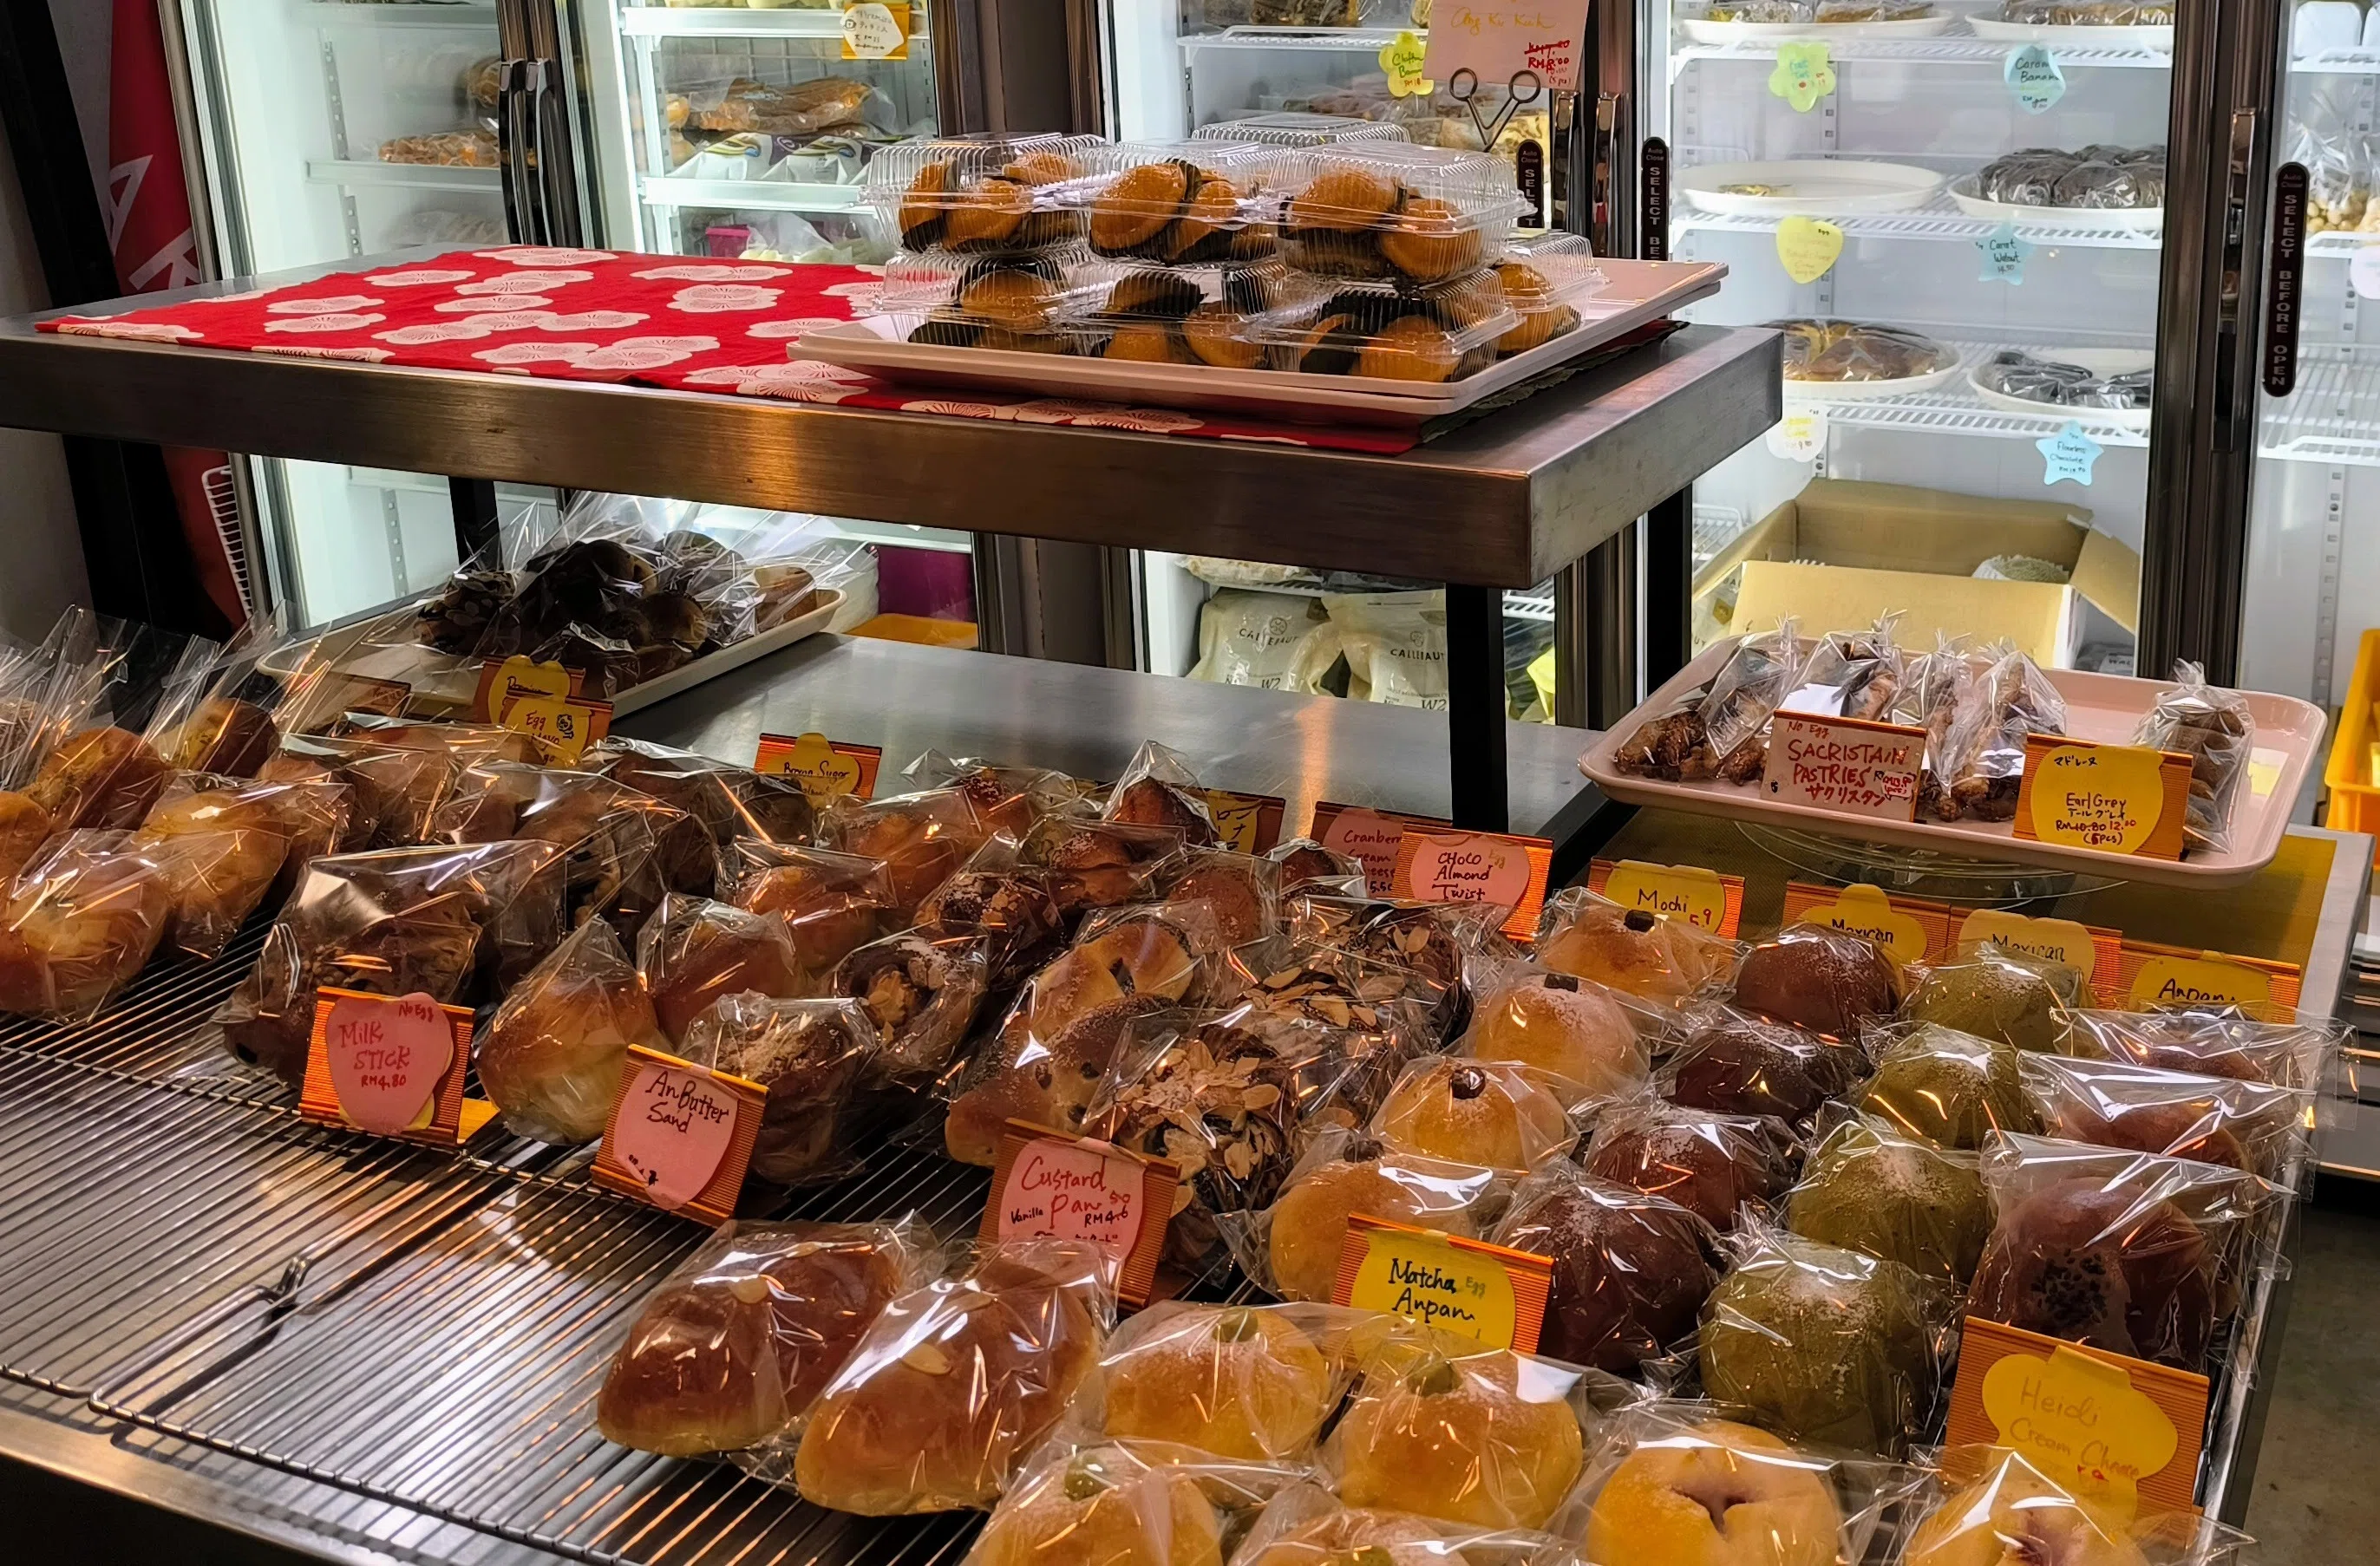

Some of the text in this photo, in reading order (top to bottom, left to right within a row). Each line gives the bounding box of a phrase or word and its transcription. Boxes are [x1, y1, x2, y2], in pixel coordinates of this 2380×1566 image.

[1525, 169, 1536, 227] SELT
[1649, 166, 1661, 226] SELECT
[2271, 194, 2298, 386] SELECT BEFORE OPEN
[526, 710, 546, 731] Egg
[1794, 763, 1873, 787] PASTRIES
[2066, 792, 2127, 816] Earl Grey
[1343, 829, 1402, 845] Cranberr
[1433, 865, 1494, 881] Almond
[1431, 883, 1486, 902] Twist
[353, 1045, 411, 1071] STICK
[646, 1101, 694, 1134] Sand
[1021, 1155, 1108, 1192] Custard
[1010, 1206, 1043, 1224] Vanilla
[1388, 1257, 1457, 1295] Matcha
[1391, 1287, 1475, 1324] Anpan
[2009, 1416, 2071, 1458] Cream
